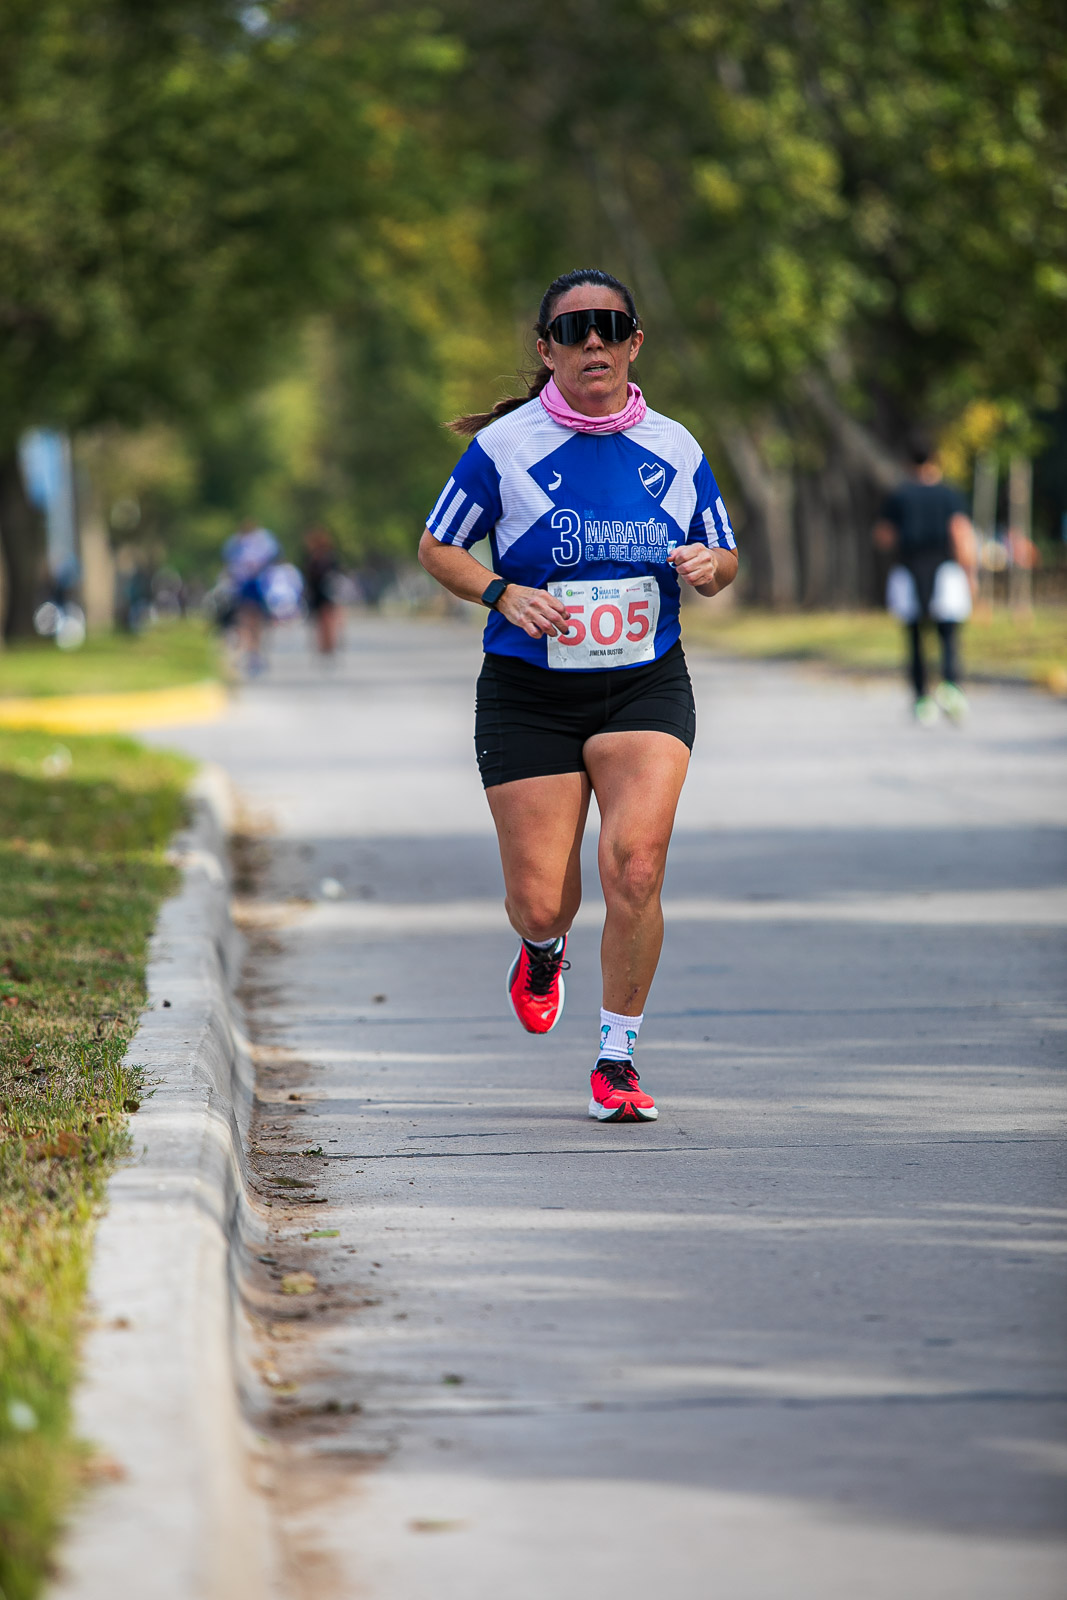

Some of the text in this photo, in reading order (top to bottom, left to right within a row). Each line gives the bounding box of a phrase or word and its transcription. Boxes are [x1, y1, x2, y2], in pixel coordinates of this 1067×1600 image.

[551, 509, 581, 567] 3
[584, 518, 669, 546] MARATÓN
[591, 586, 599, 601] 3
[557, 600, 650, 646] 505
